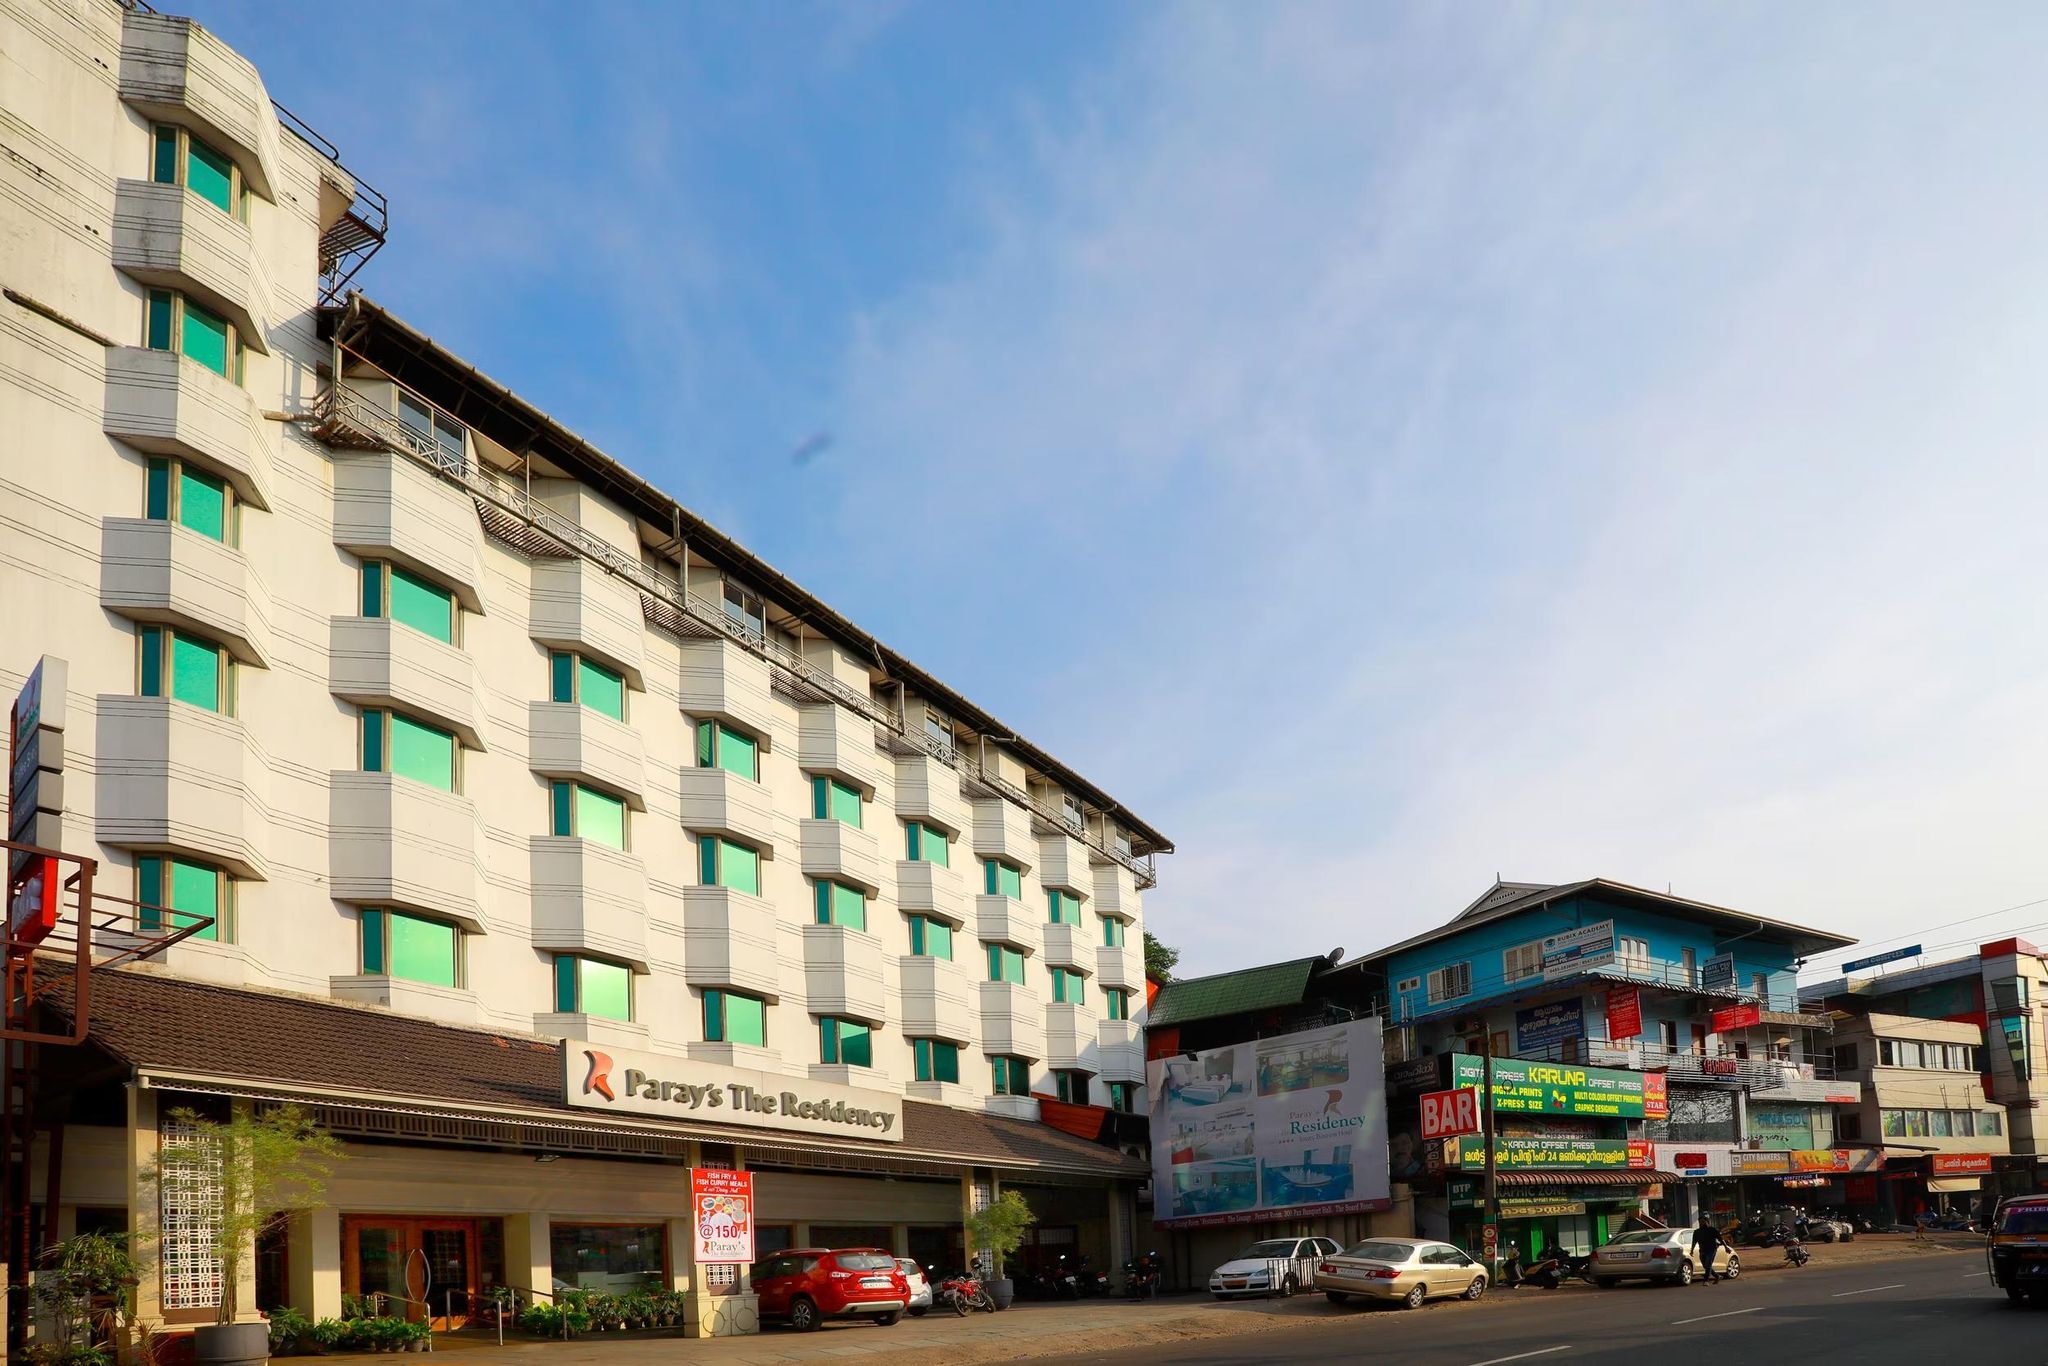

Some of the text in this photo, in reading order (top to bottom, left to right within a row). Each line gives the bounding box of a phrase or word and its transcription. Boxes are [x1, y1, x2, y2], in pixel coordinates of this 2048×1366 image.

[1557, 932, 1578, 942] RUBIX
[1578, 923, 1610, 936] ACADEMY
[1704, 1058, 1737, 1074] CASANOVA
[1496, 1070, 1525, 1081] PRESS
[1528, 1067, 1586, 1086] KARUNA
[1588, 1078, 1616, 1089] OFFSET
[1618, 1081, 1642, 1090] PRESS
[1492, 1084, 1518, 1096] DIGITAL
[1519, 1088, 1542, 1098] PRINTS
[624, 1068, 896, 1132] Paray's The Residency
[1574, 1091, 1588, 1100] MULTI
[1588, 1092, 1606, 1101] COLOUR
[1606, 1094, 1622, 1102] OFFSET
[1623, 1095, 1642, 1104] PRINTING
[1497, 1098, 1543, 1110] X-PRESS SIZE
[1574, 1103, 1619, 1114] GRAPHIC DESIGNING
[1646, 1102, 1664, 1110] STAR
[1423, 1092, 1475, 1135] BAR
[1290, 1116, 1366, 1134] Residency
[1508, 1141, 1540, 1149] KARUNA
[1571, 1142, 1596, 1150] PRESS
[1548, 1152, 1557, 1161] 24
[1628, 1149, 1642, 1158] STAR
[1742, 1153, 1781, 1161] CITY BANKERS
[707, 1172, 721, 1180] FISH
[1452, 1184, 1471, 1194] DTP
[1496, 1186, 1536, 1198] RAPHIC
[1538, 1185, 1568, 1196] ZONE
[711, 1241, 746, 1252] Paray's
